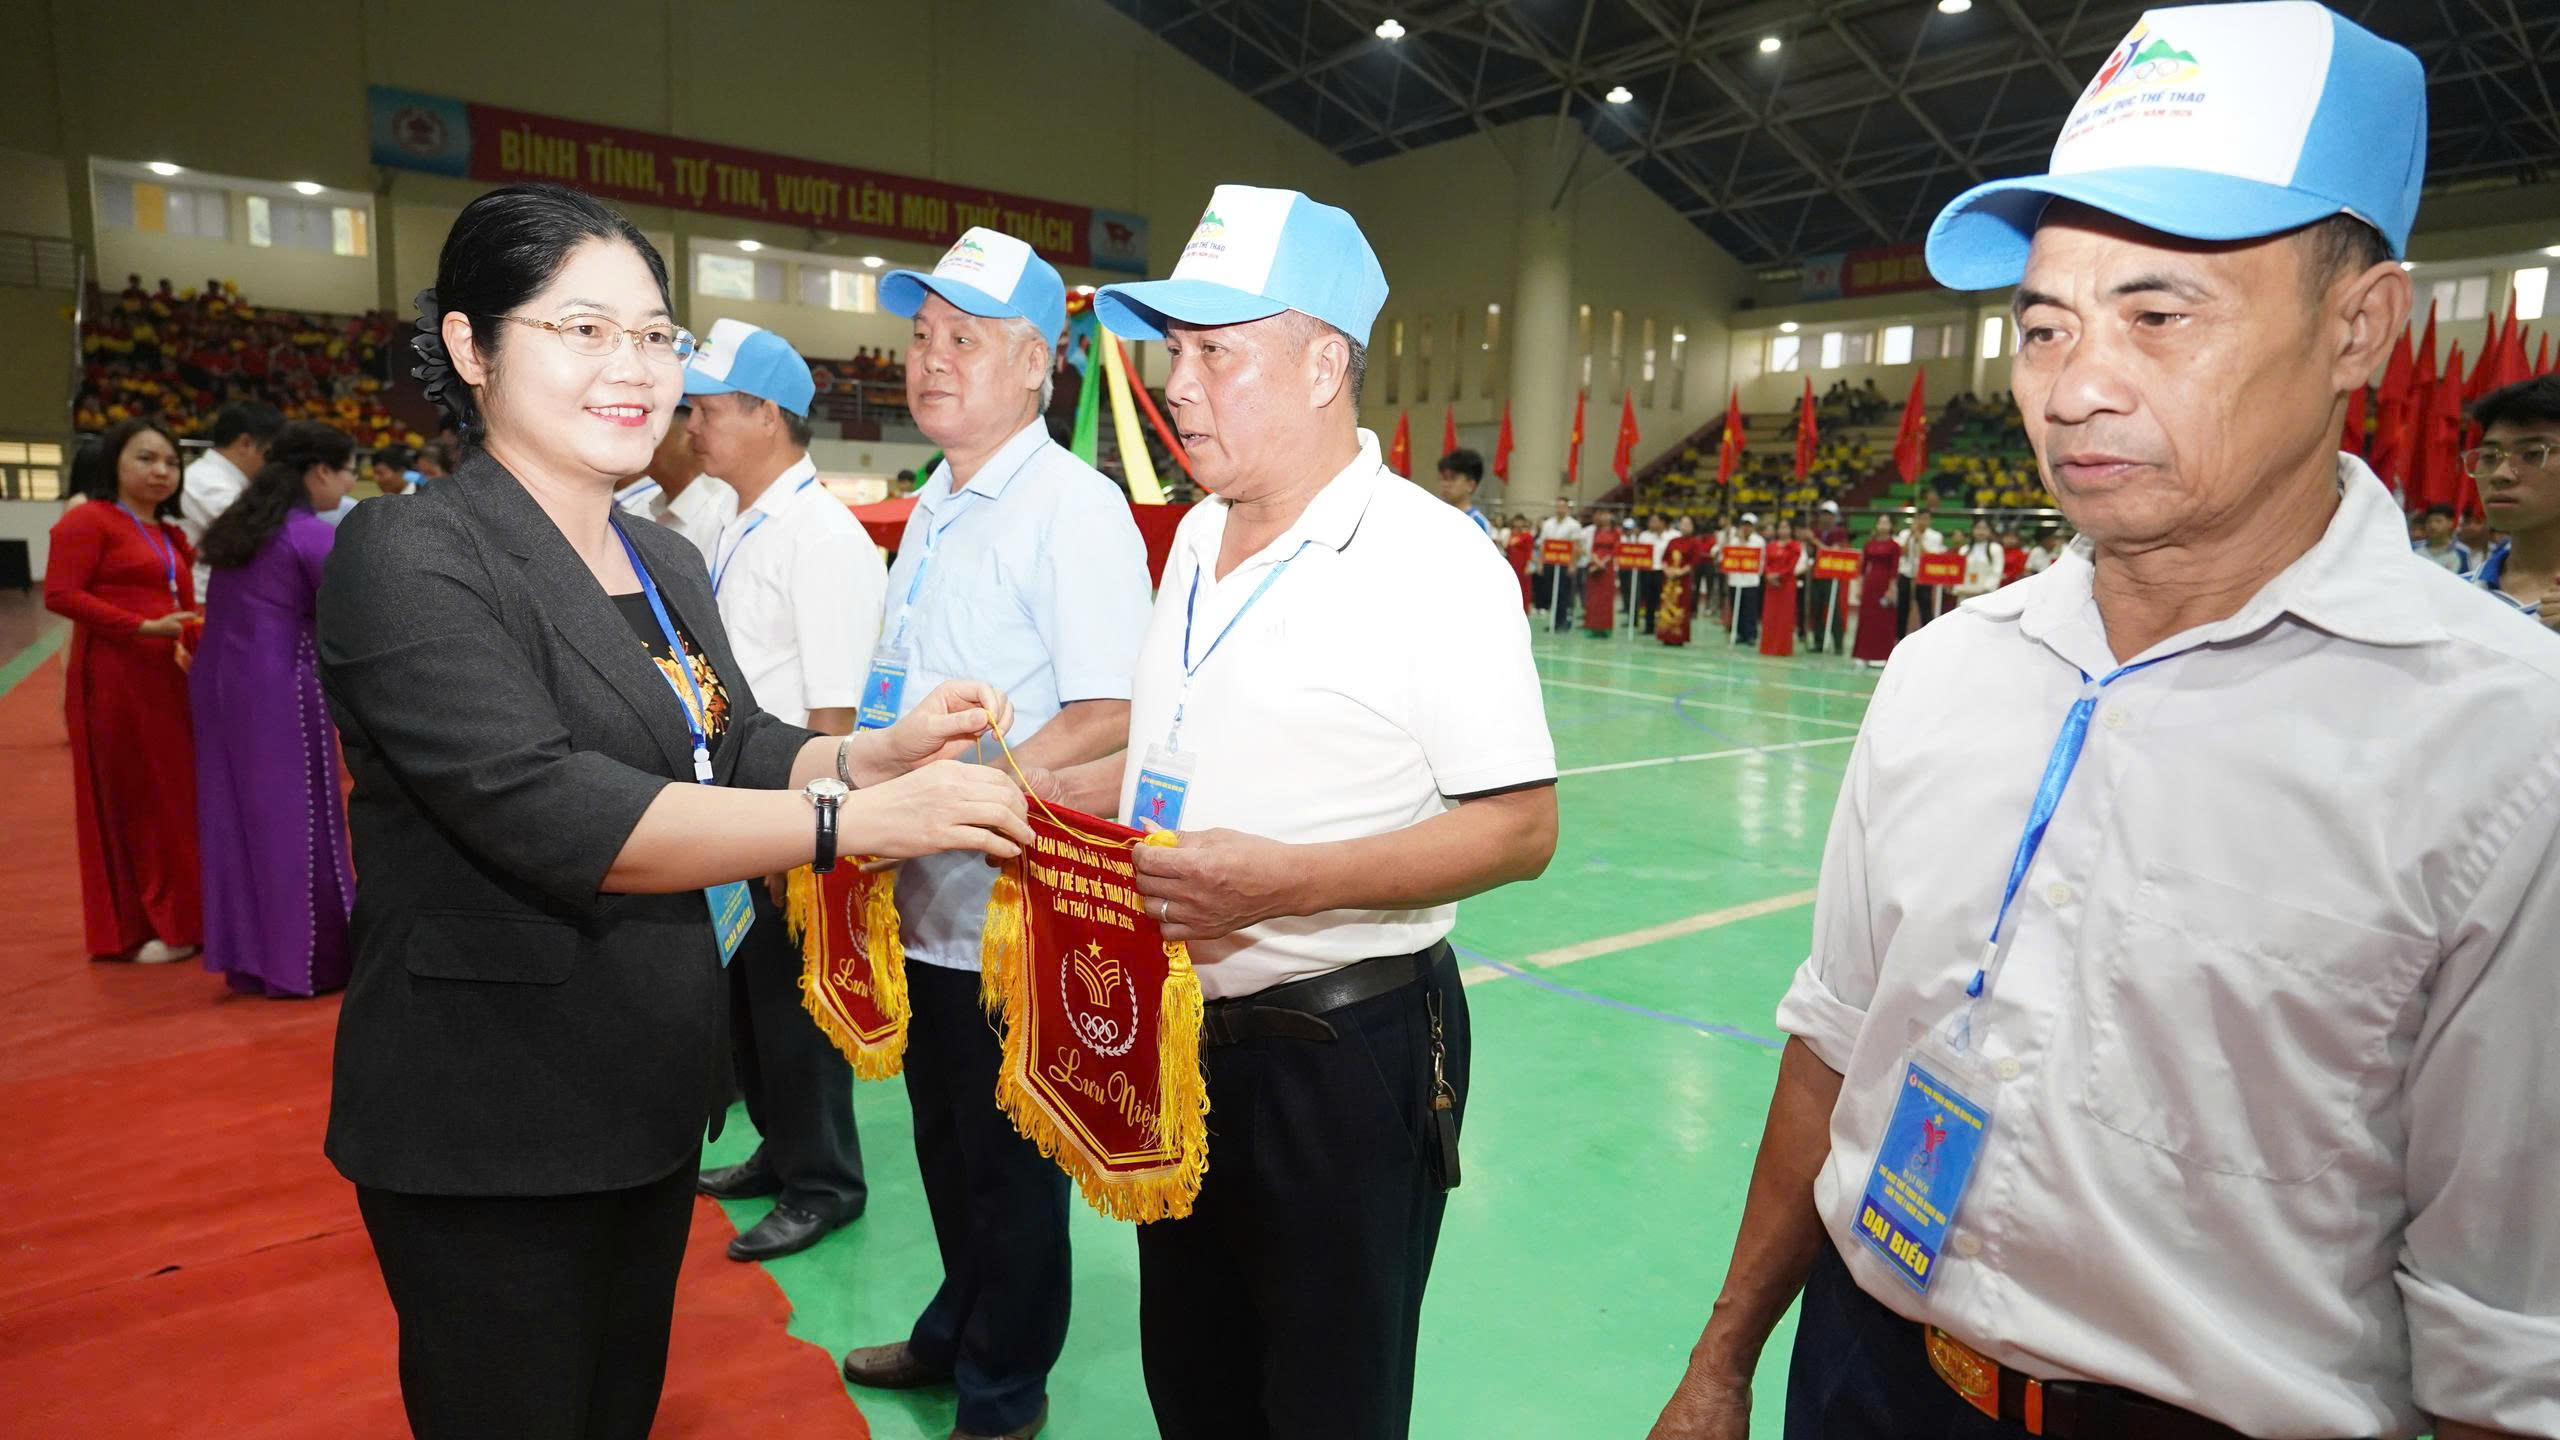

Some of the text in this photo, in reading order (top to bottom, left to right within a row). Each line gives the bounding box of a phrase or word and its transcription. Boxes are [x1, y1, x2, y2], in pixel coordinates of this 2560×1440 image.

[2168, 92, 2206, 104] THAO
[501, 121, 1074, 252] BÌNH TĨNH, TỰ TIN, VƯỢT LÊN MỌI THỬ THÁCH
[1037, 835, 1056, 856] BAN
[1056, 840, 1081, 863] NHÂN
[1079, 846, 1100, 869] DÂN
[1099, 853, 1115, 873] XÃ
[1110, 860, 1137, 880] ĐỊNH
[1045, 866, 1059, 891] HỘI
[1059, 867, 1074, 892] THỂ
[1074, 875, 1089, 898] DỤC
[1088, 875, 1105, 899] THỂ
[1103, 882, 1123, 905] THAO
[1053, 892, 1069, 915] LẦN
[1069, 899, 1089, 919] THỨ
[1089, 904, 1096, 923] I,
[1096, 904, 1117, 926] NĂM
[1048, 1046, 1107, 1105] Lưu
[1861, 1205, 1930, 1277] ĐẠI BIỂU
